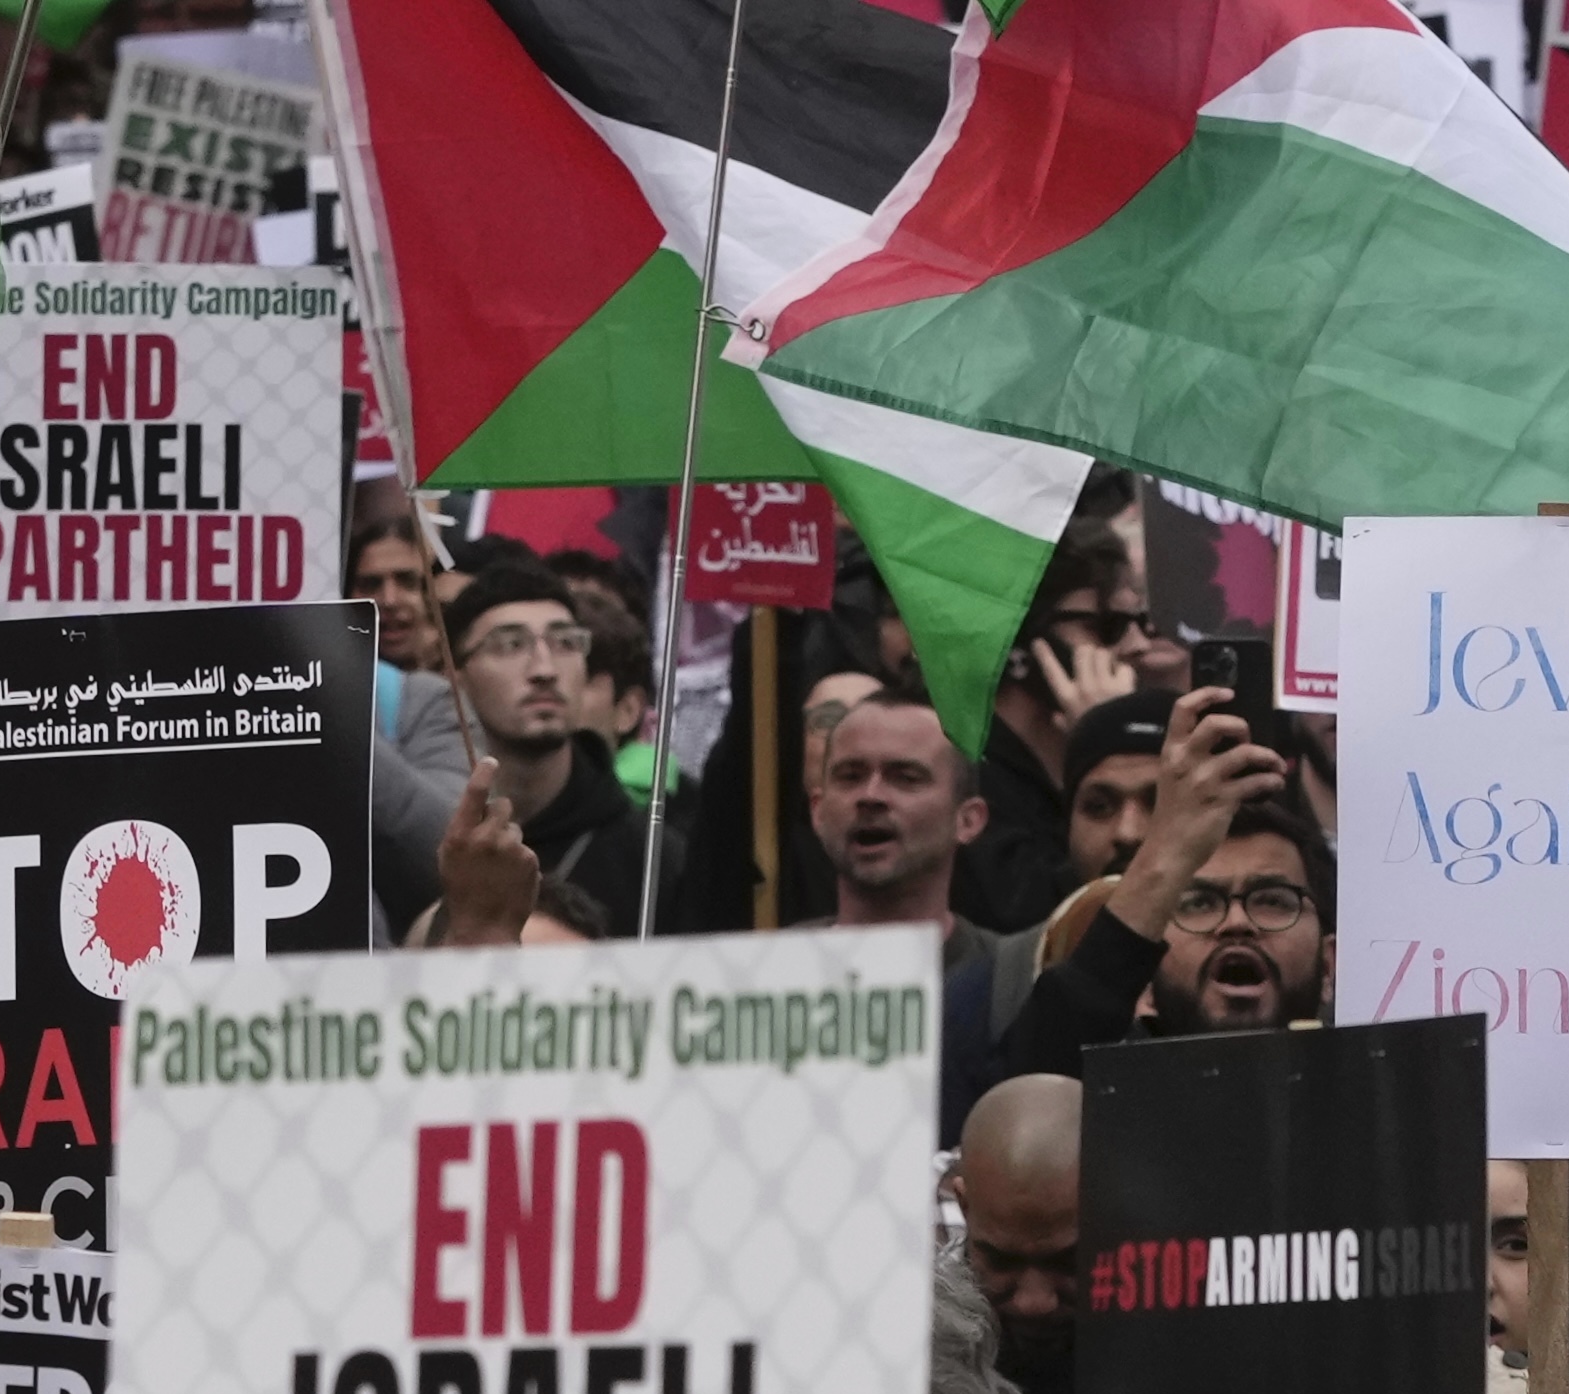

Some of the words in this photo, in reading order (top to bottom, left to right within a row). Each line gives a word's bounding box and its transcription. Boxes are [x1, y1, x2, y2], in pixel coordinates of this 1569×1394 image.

[129, 60, 180, 109] FREE
[36, 281, 177, 318] Solidarity
[187, 283, 338, 318] Campaign
[43, 333, 177, 421] END
[698, 524, 820, 573] لفلسطين
[64, 675, 98, 711] في
[107, 667, 225, 703] الفلسطيني
[233, 661, 323, 698] المنتدى
[116, 713, 200, 743] Forum
[206, 711, 230, 738] in
[235, 705, 321, 736] Britain
[131, 1002, 381, 1087] Palestine
[402, 987, 652, 1080] Solidarity
[672, 970, 927, 1075] Campaign
[409, 1117, 652, 1340] END
[1090, 1221, 1474, 1313] #STOPARMINGISRAEL
